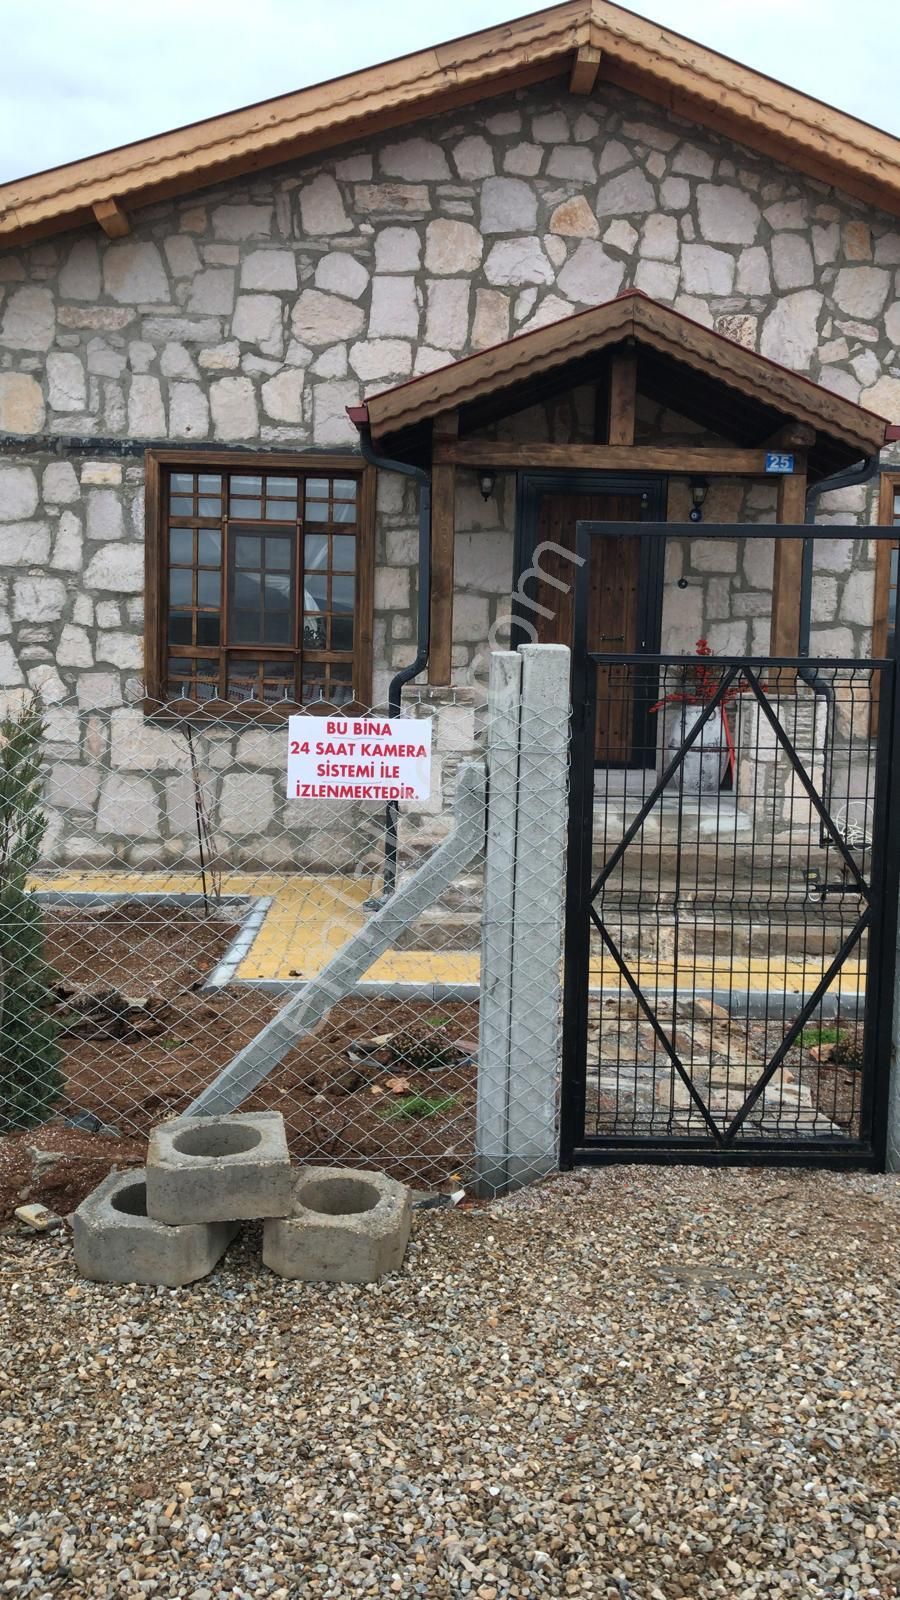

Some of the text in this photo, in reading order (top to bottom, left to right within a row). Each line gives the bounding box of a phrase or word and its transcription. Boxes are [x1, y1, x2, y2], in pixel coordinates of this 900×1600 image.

[770, 456, 790, 468] 25
[326, 718, 392, 736] BU BİNA
[290, 741, 427, 757] 24 SAAT KAMERA
[317, 760, 400, 778] SİSTEMİ İLE
[296, 780, 419, 799] İZLENMEKTEDİR.
